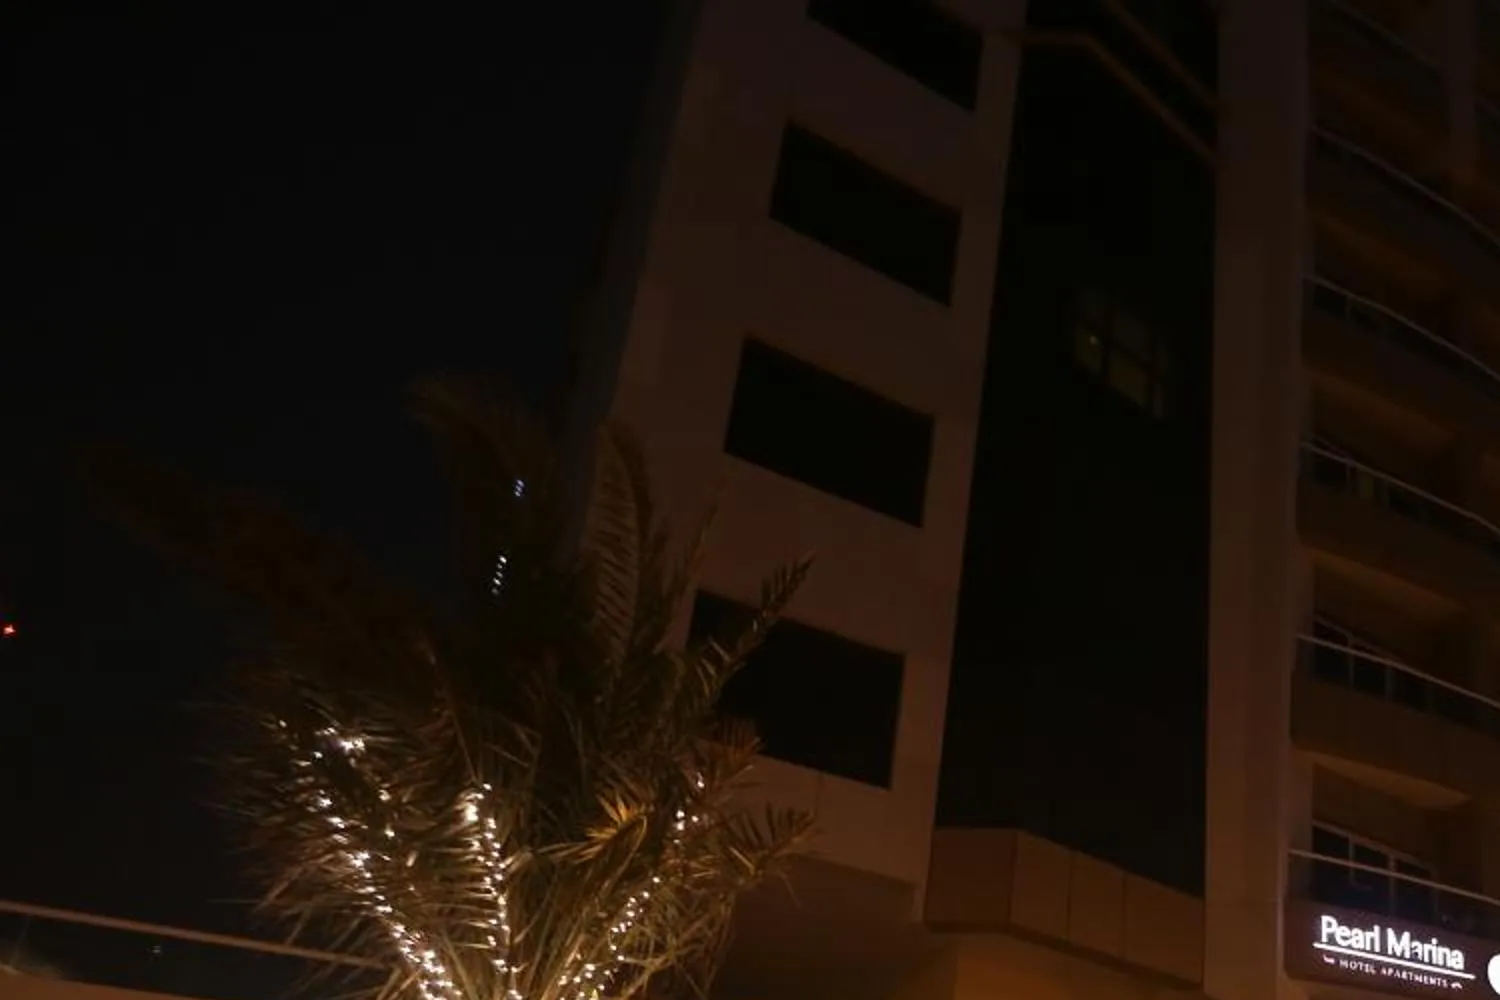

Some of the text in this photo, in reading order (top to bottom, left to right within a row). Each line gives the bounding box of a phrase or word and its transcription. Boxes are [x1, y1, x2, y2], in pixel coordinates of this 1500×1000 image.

[1320, 914, 1466, 971] Pearl Marina
[1339, 958, 1449, 988] HOTEL APARTMENTS
